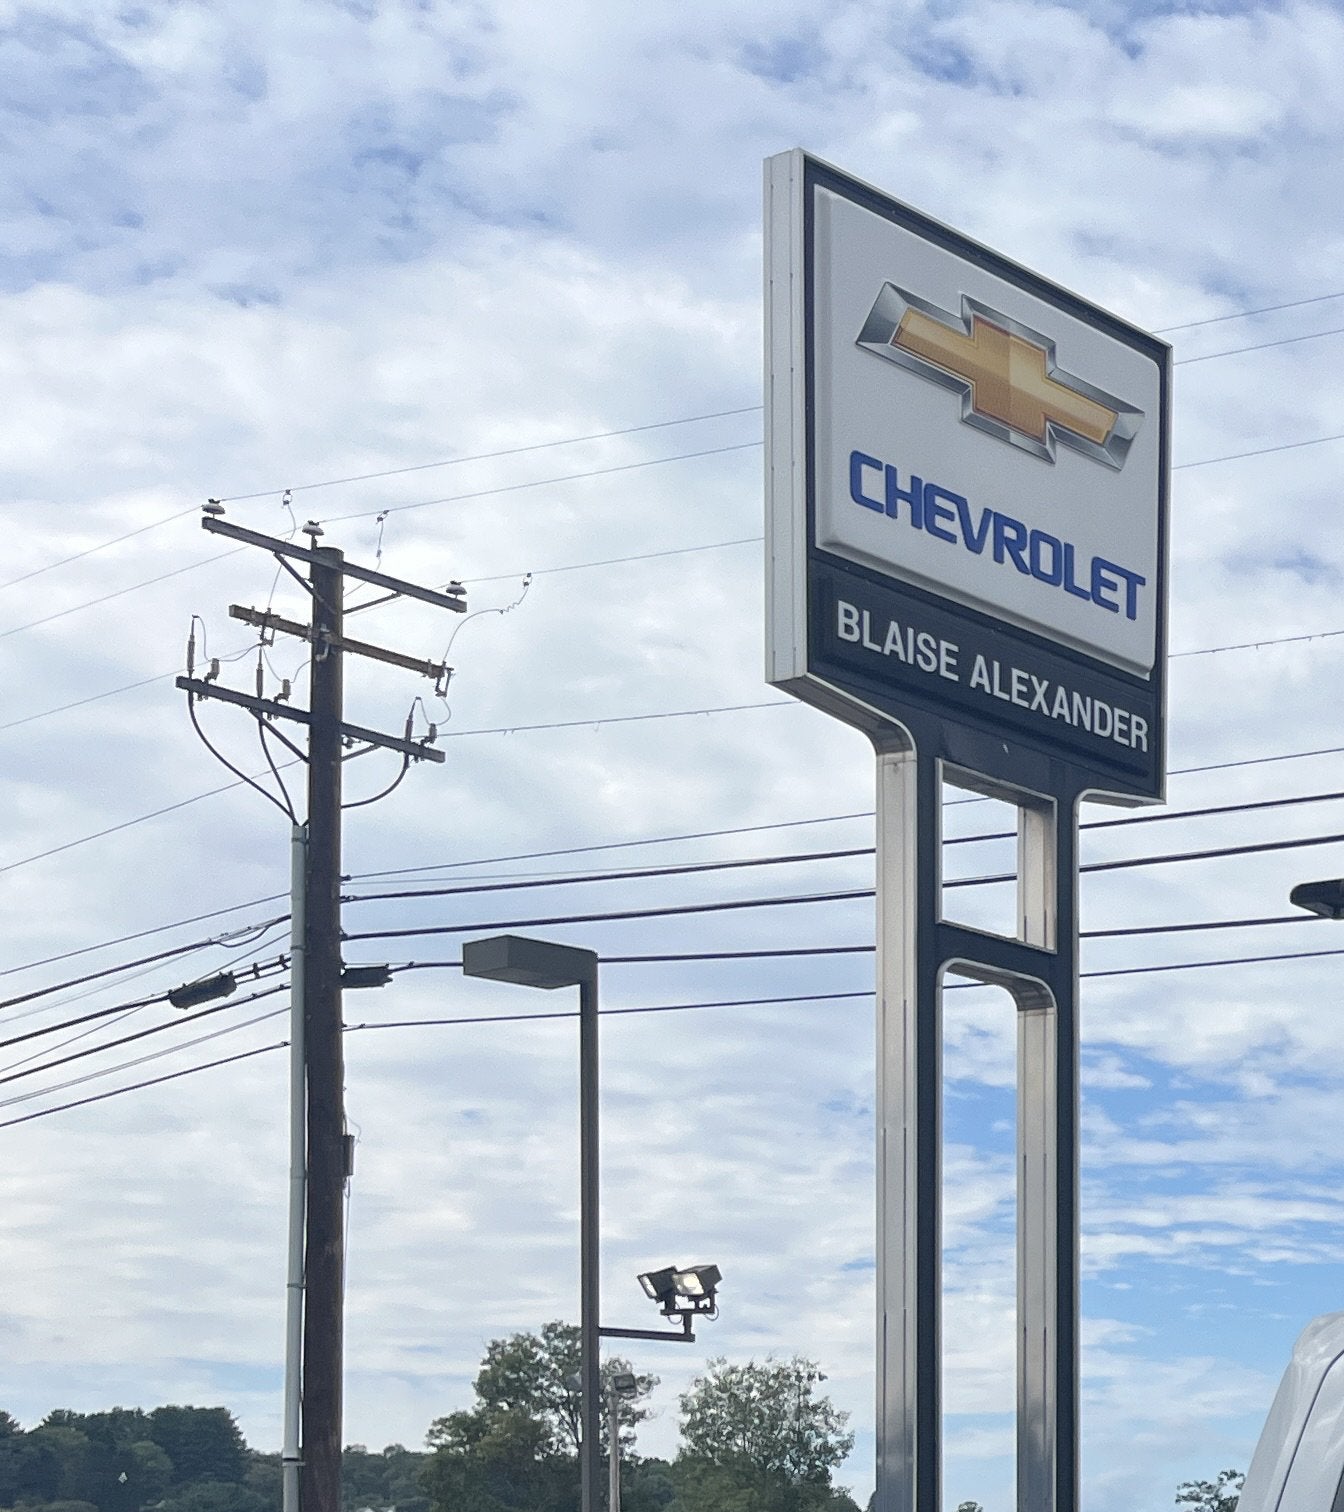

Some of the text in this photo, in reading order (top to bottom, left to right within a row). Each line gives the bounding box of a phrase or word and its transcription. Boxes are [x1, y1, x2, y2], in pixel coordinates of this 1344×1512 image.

[850, 450, 1146, 621] CHEVROLET
[837, 599, 1148, 752] BLAISE ALEXANDER
